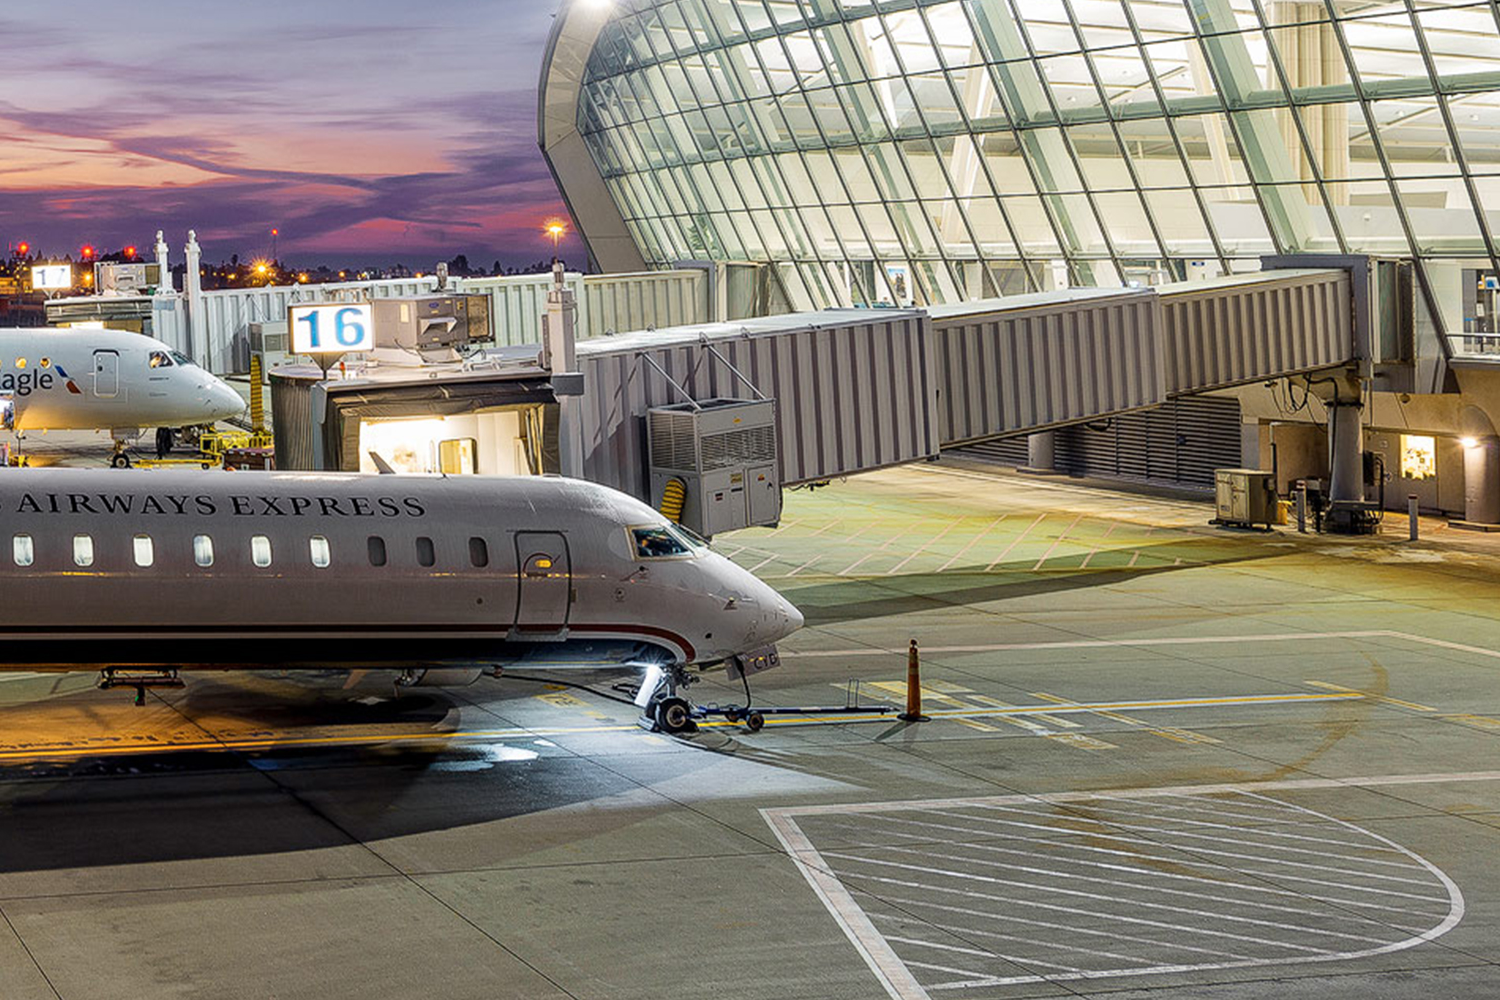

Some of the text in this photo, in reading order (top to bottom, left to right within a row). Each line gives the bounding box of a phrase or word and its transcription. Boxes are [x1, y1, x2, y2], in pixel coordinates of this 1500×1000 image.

[35, 268, 66, 285] 17
[297, 307, 365, 347] 16
[16, 492, 217, 516] AIRWAYS
[228, 494, 426, 518] EXPRESS
